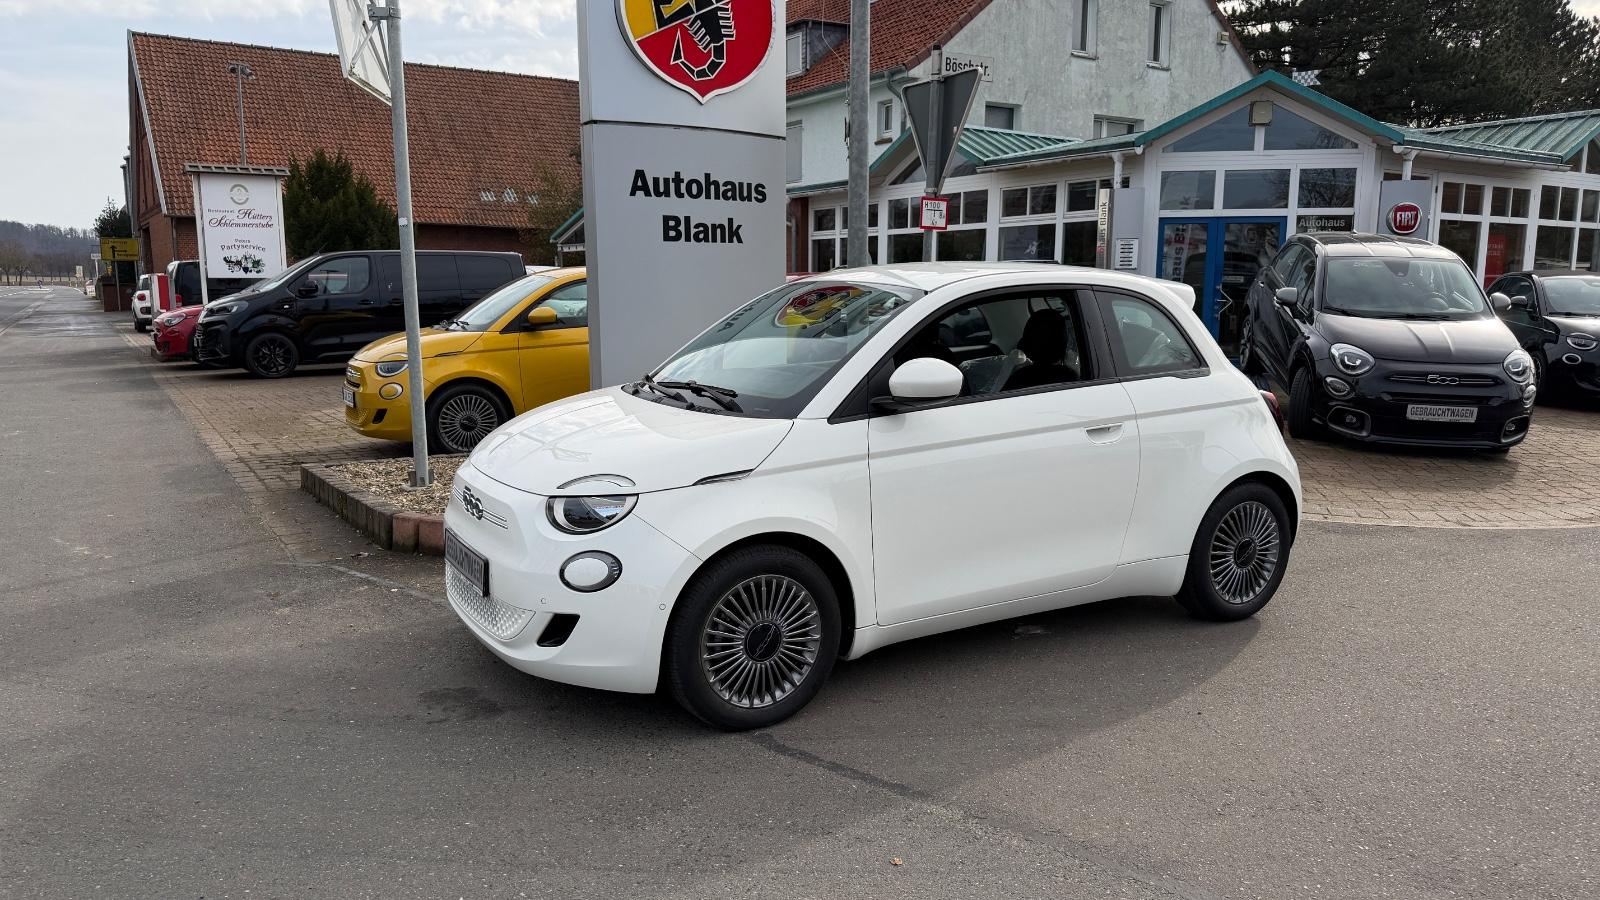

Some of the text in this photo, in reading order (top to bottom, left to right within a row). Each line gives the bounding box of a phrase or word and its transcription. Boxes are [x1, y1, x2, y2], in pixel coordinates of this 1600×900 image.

[629, 169, 767, 203] Autohaus
[1099, 201, 1108, 226] Blank
[1396, 211, 1417, 226] FIAT
[208, 215, 274, 229] Schlemmerstube
[662, 214, 743, 244] Blank
[1299, 218, 1345, 227] Autohaus
[220, 243, 266, 252] Partyservice
[1427, 374, 1459, 385] 500
[1410, 406, 1474, 418] GEBRAUCHTWAGEN
